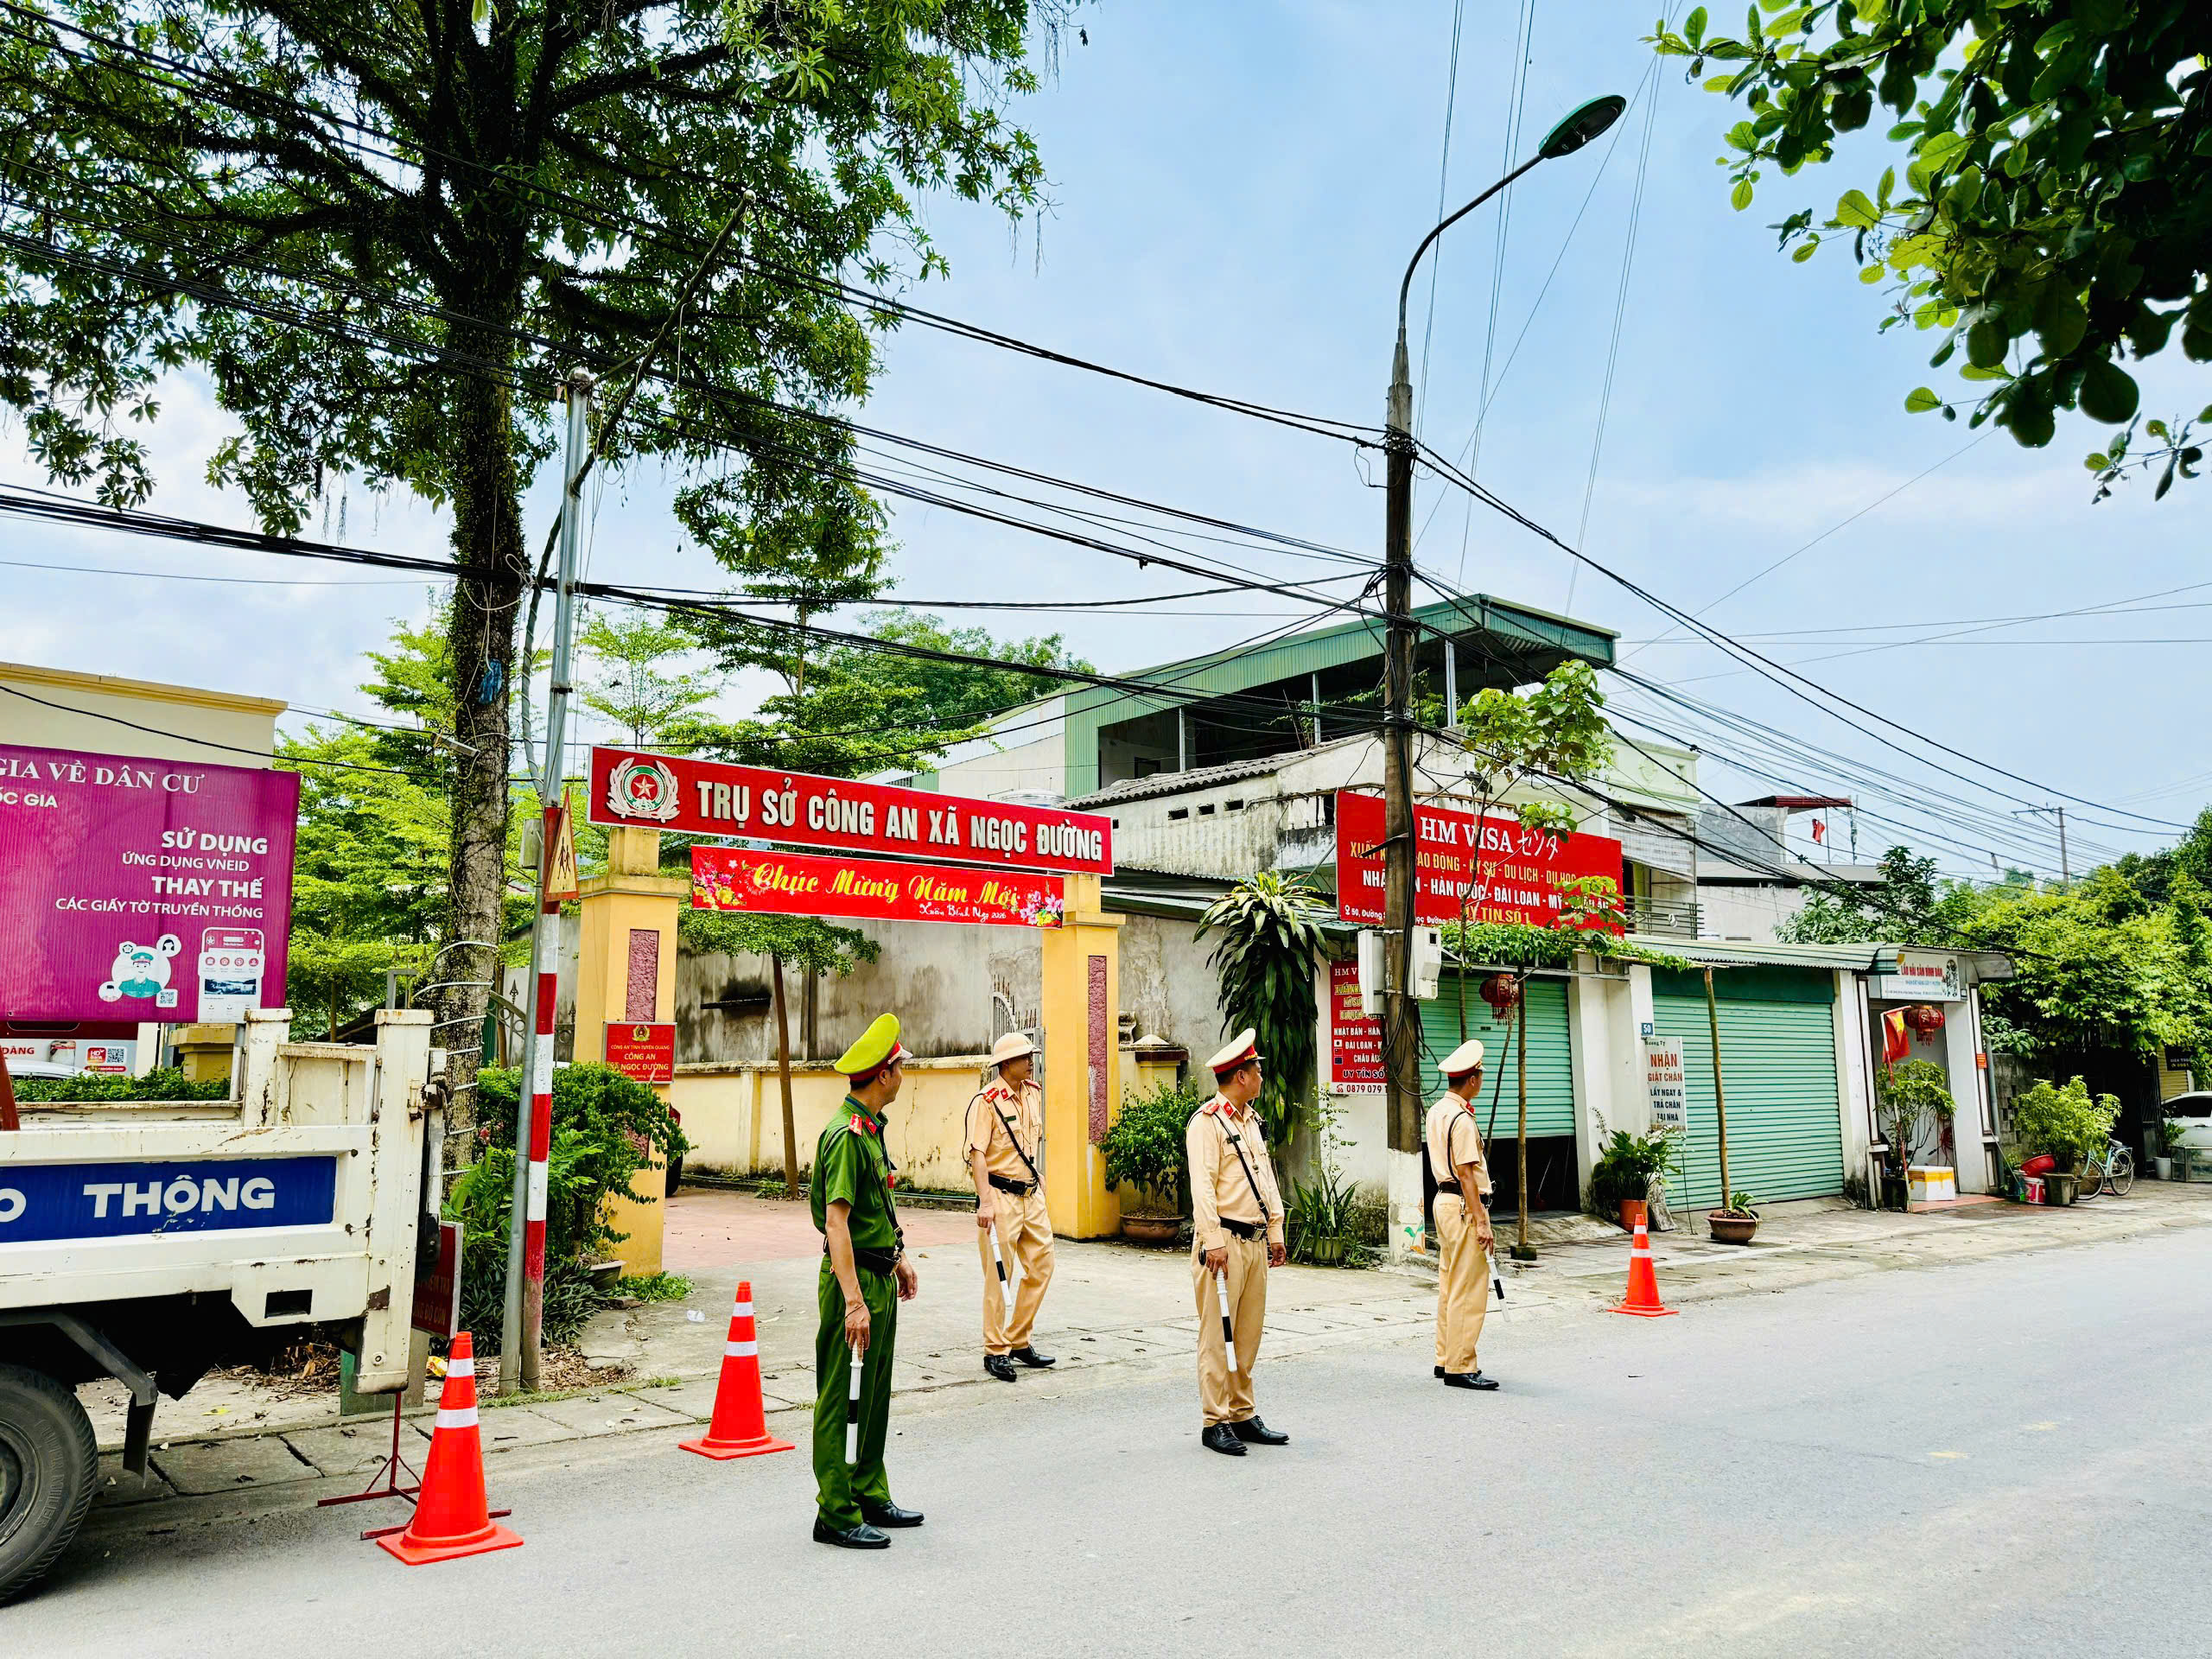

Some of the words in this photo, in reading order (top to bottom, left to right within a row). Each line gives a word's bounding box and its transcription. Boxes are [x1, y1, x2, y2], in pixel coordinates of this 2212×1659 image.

[48, 760, 86, 783] VỀ
[93, 765, 156, 789] DÂN
[162, 773, 205, 793] CƯ
[24, 793, 58, 808] GIA
[696, 780, 750, 829] TRỤ
[761, 777, 798, 827] SỞ
[808, 788, 874, 836] CÔNG
[885, 805, 918, 842] AN
[928, 805, 960, 846] XÃ
[970, 815, 1027, 858] NGỌC
[1036, 818, 1103, 861] ĐƯỜNG
[162, 827, 195, 849] SỬ
[200, 834, 268, 855] DỤNG
[1420, 816, 1458, 844] HM
[1463, 823, 1514, 854] VISA
[122, 851, 156, 865] ỨNG
[161, 855, 203, 869] DỤNG
[207, 859, 250, 872] VNEID
[1415, 850, 1430, 868] AO
[1433, 851, 1460, 873] ĐỘNG
[1504, 864, 1516, 878] DU
[1519, 866, 1539, 884] LỊCH
[151, 876, 214, 896] THAY
[219, 877, 264, 899] THẾ
[753, 863, 819, 893] Chúc
[825, 869, 900, 904] Mừng
[908, 874, 969, 904] Năm
[974, 880, 1018, 906] Mới
[1431, 876, 1453, 896] HÀN
[1495, 884, 1511, 904] ĐÀI
[1515, 890, 1540, 907] LOAN
[1548, 893, 1562, 909] MỸ
[55, 896, 87, 910] CÁC
[91, 899, 127, 912] GIẤY
[130, 900, 151, 912] TỜ
[152, 901, 210, 917] TRUYỀN
[213, 902, 263, 918] THỐNG
[1351, 909, 1361, 918] 50,
[1362, 909, 1382, 919] Đường
[1481, 906, 1502, 922] TÍN
[1504, 907, 1522, 924] SỐ
[1643, 1025, 1651, 1033] 50
[624, 1052, 644, 1060] CÔNG
[1357, 1041, 1372, 1050] LOAN
[621, 1063, 640, 1071] NGỌC
[642, 1062, 669, 1071] ĐƯỜNG
[1650, 1051, 1677, 1071] NHẬN
[1343, 1070, 1354, 1078] UY
[1356, 1067, 1371, 1078] TÍN
[1372, 1066, 1385, 1078] SỐ
[1346, 1084, 1365, 1093] 0879
[1367, 1084, 1382, 1093] 079
[83, 1175, 275, 1218] THÔNG
